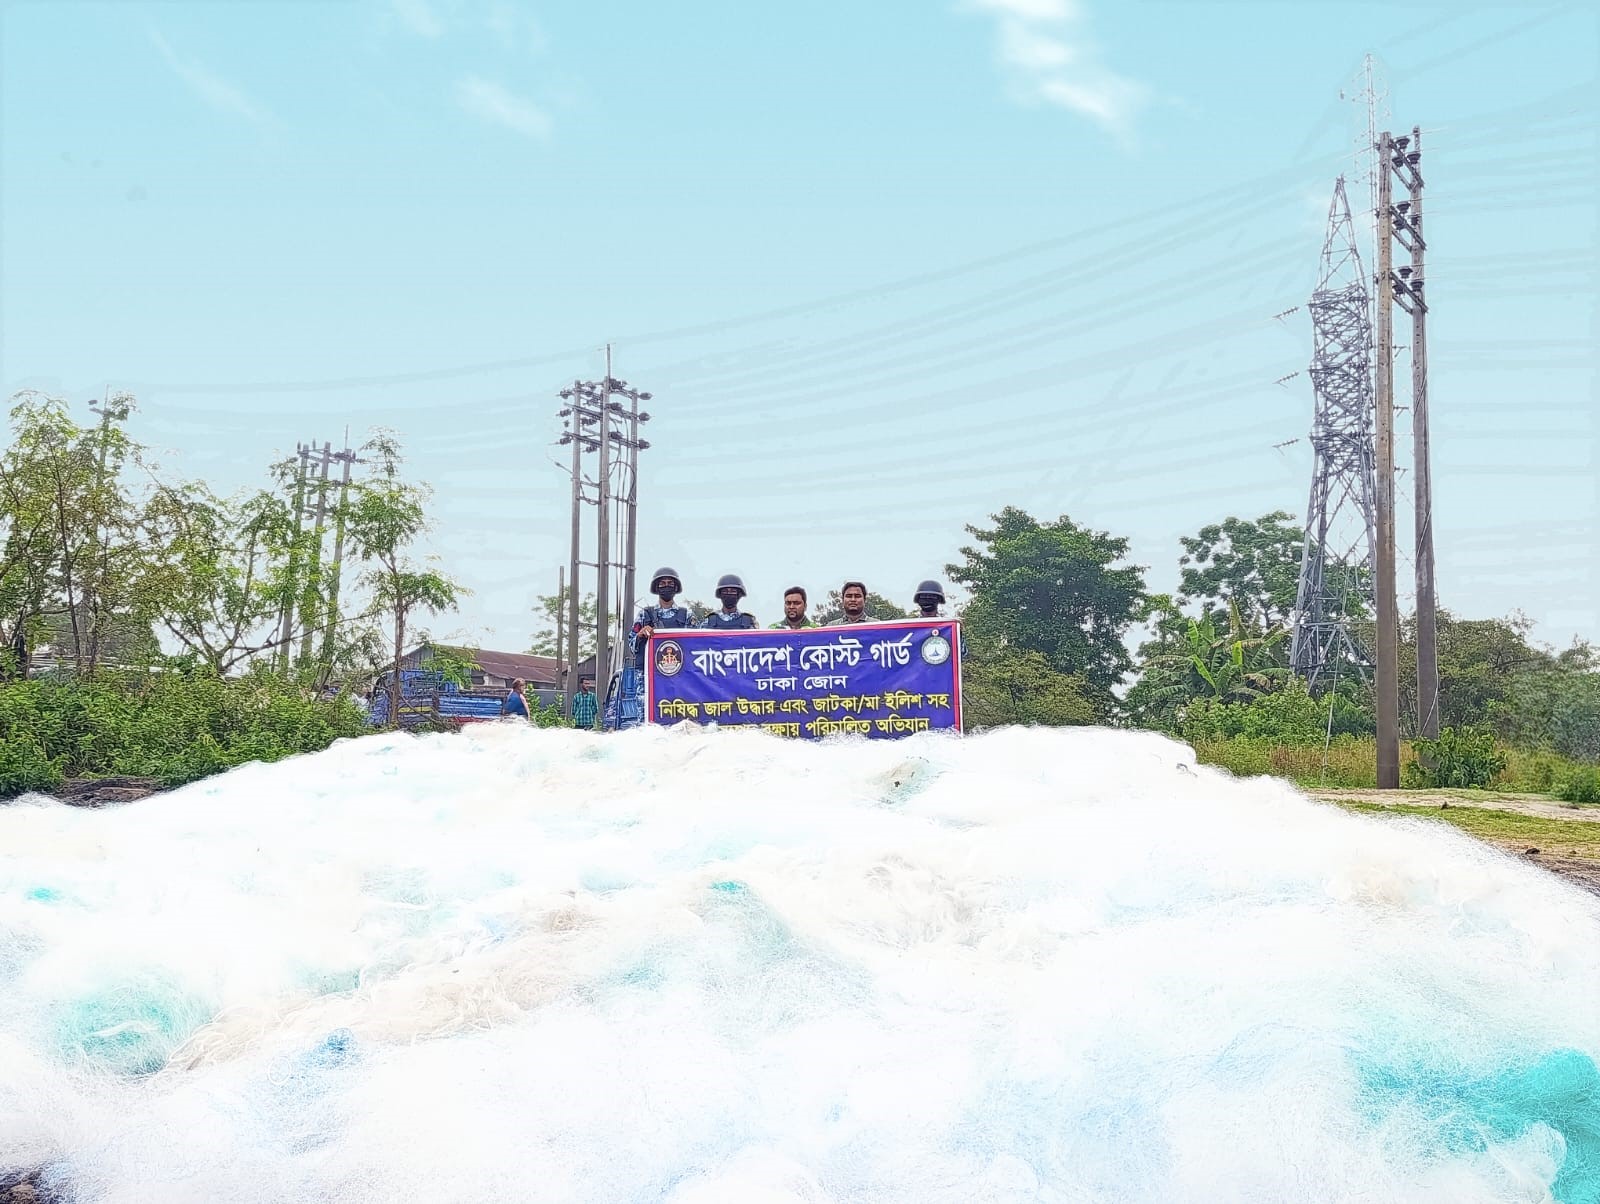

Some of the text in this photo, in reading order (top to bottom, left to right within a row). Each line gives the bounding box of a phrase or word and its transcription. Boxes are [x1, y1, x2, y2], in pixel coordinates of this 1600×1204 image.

[691, 644, 793, 676] বাংলাদেশ
[800, 635, 863, 671] কোস্ট
[870, 632, 913, 668] গার্ড
[755, 675, 848, 692] ঢাকা জোন
[658, 690, 951, 718] নিষিদ্ধ জাল উদ্ধার এবং জাটকা/মা ইলিশ সহ
[805, 714, 872, 736] পরিচালিত
[875, 714, 930, 733] অভিযান
